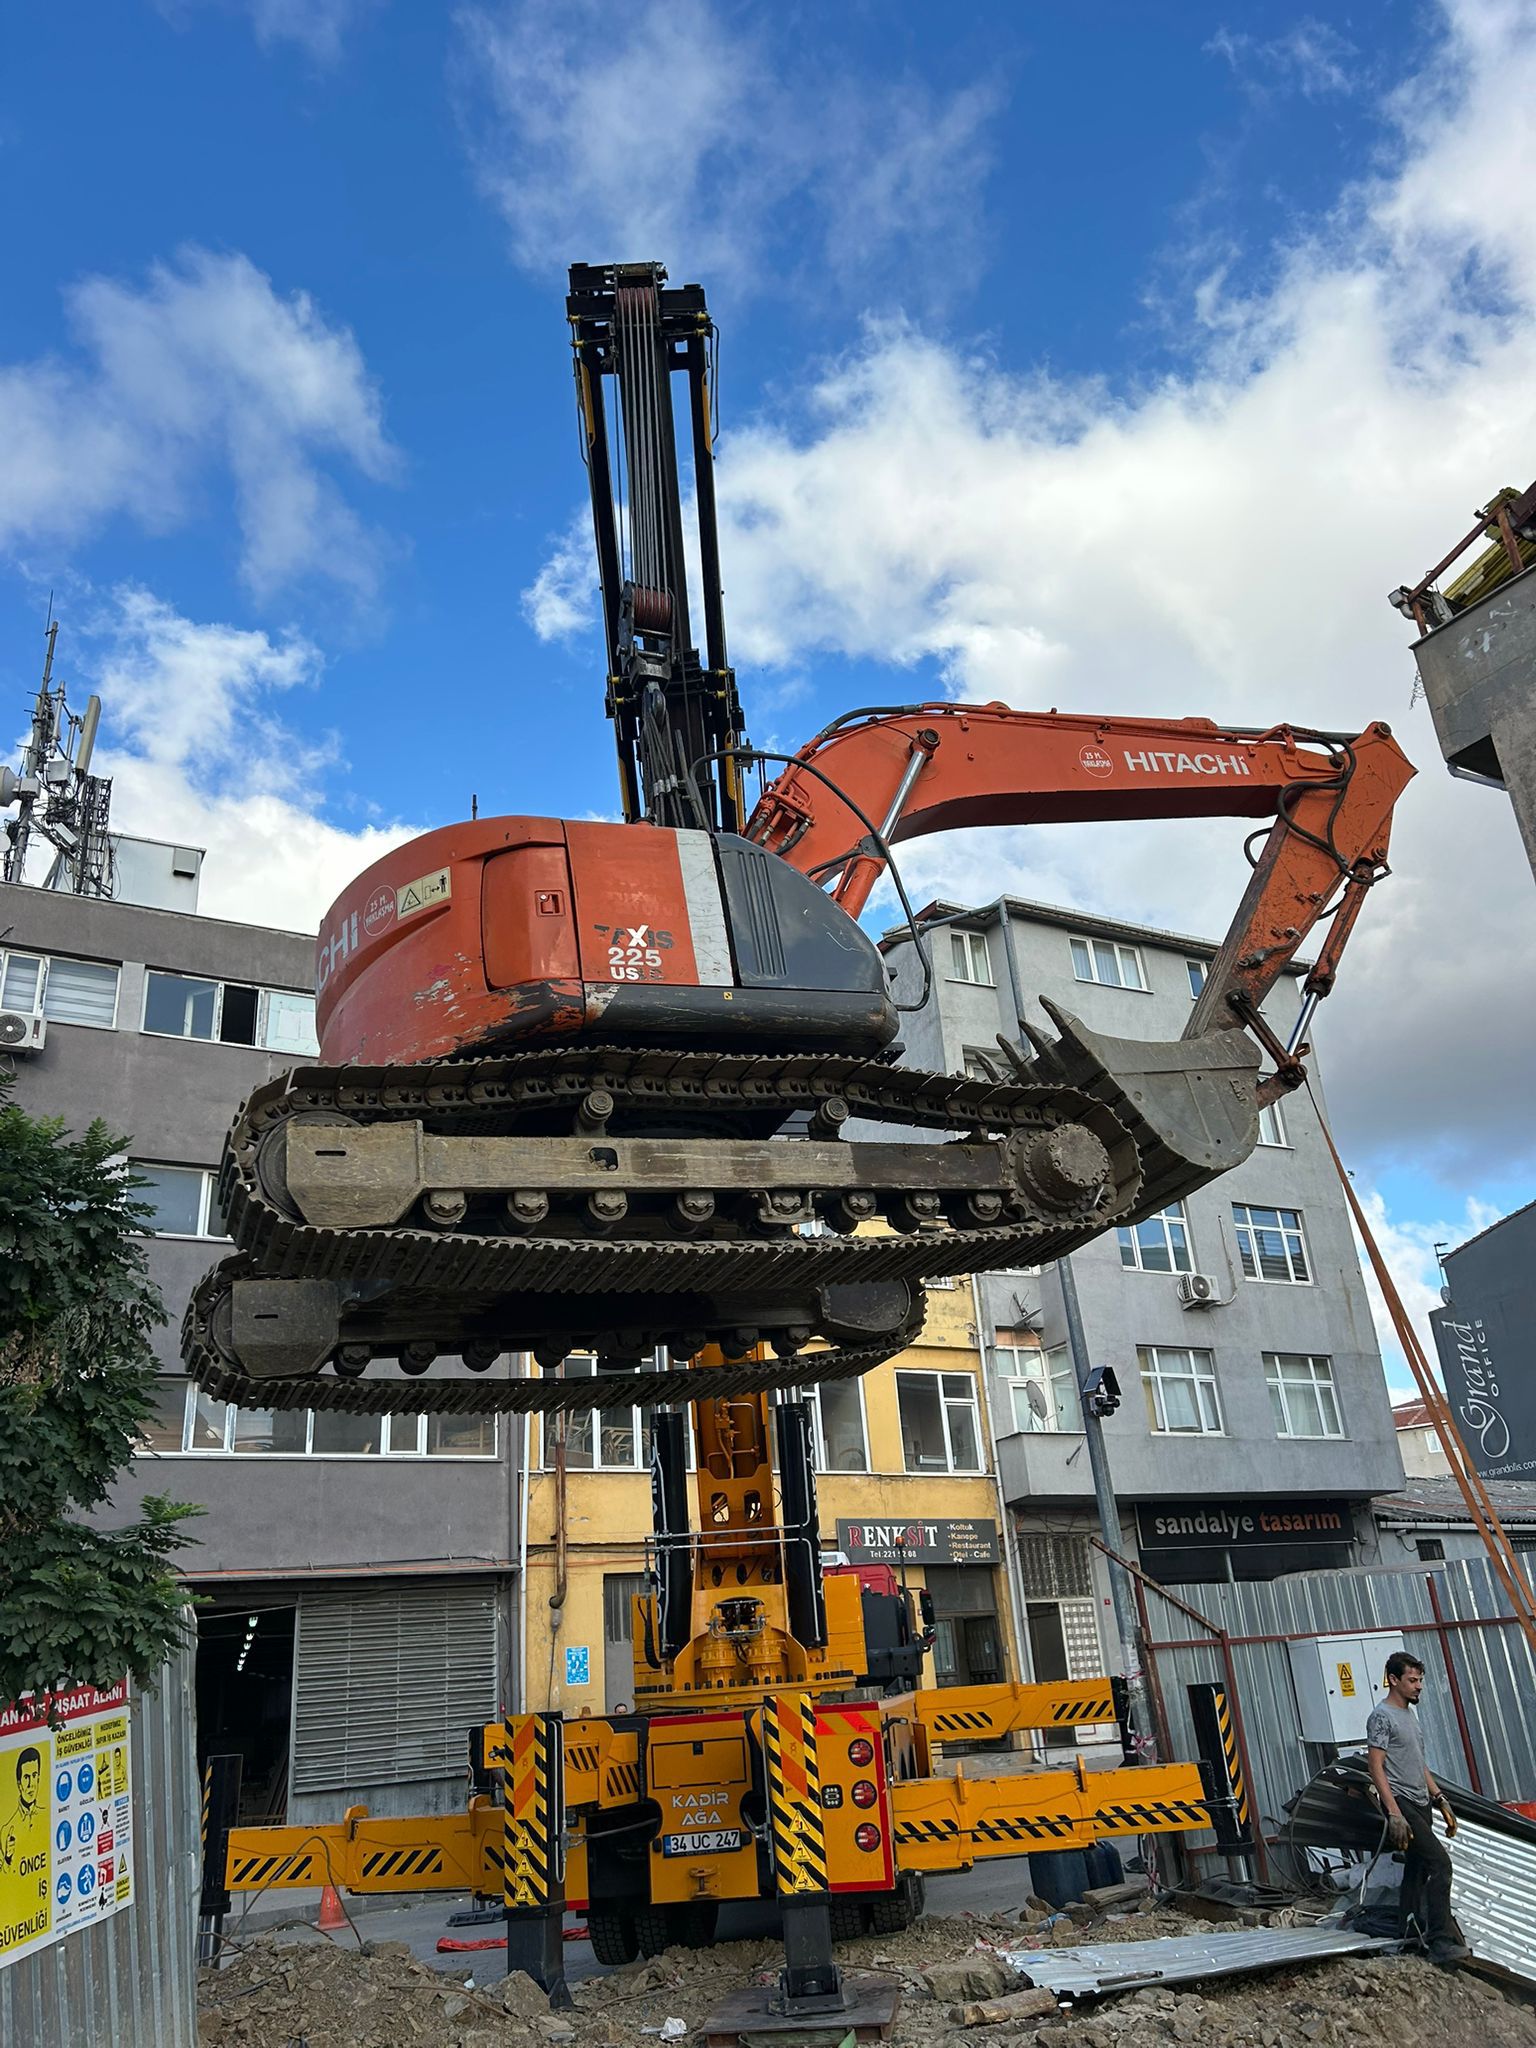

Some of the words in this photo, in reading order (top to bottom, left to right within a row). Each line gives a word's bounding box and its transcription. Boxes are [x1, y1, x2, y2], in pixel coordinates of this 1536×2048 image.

[1123, 751, 1250, 775] HITACHI
[315, 911, 359, 1000] CHI
[608, 947, 662, 967] 225
[1475, 1319, 1499, 1397] OFFICE
[1441, 1319, 1510, 1458] Grand
[848, 1520, 937, 1548] RENKSİT
[1155, 1510, 1254, 1539] sandalye
[1259, 1512, 1342, 1532] tasarım
[950, 1533, 978, 1541] Kanepe
[973, 1550, 991, 1558] Cafe
[672, 1789, 729, 1808] KADİR
[681, 1807, 722, 1826] AĞA
[671, 1836, 687, 1851] 34
[691, 1834, 710, 1849] UC
[716, 1831, 738, 1847] 247
[19, 1852, 46, 1876] ÖNCE
[38, 1878, 47, 1900] İŞ
